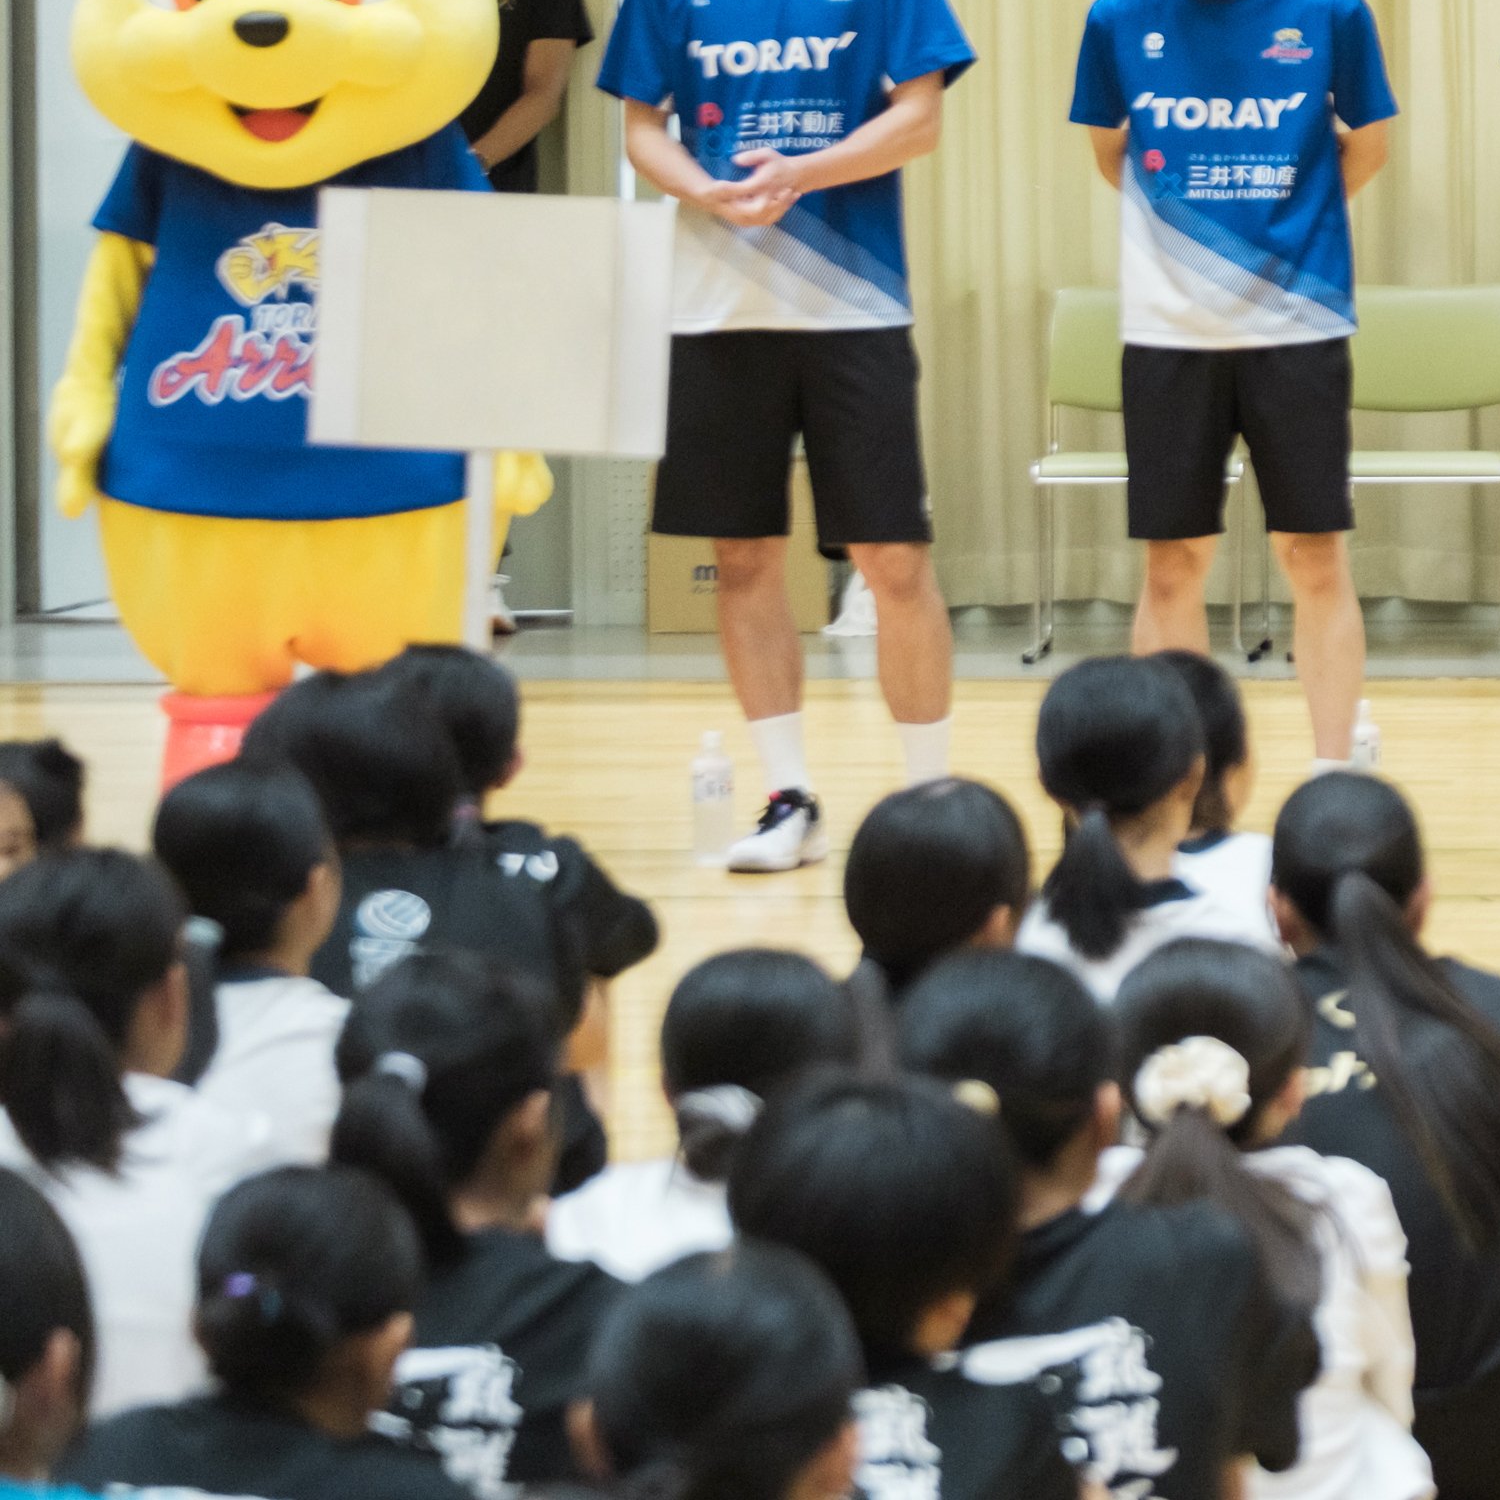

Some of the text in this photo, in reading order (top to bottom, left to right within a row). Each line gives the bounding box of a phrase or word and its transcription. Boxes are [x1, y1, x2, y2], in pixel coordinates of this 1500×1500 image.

[738, 110, 845, 139] 三井不動産
[1187, 164, 1298, 187] 三井不動産
[253, 303, 317, 333] TOR
